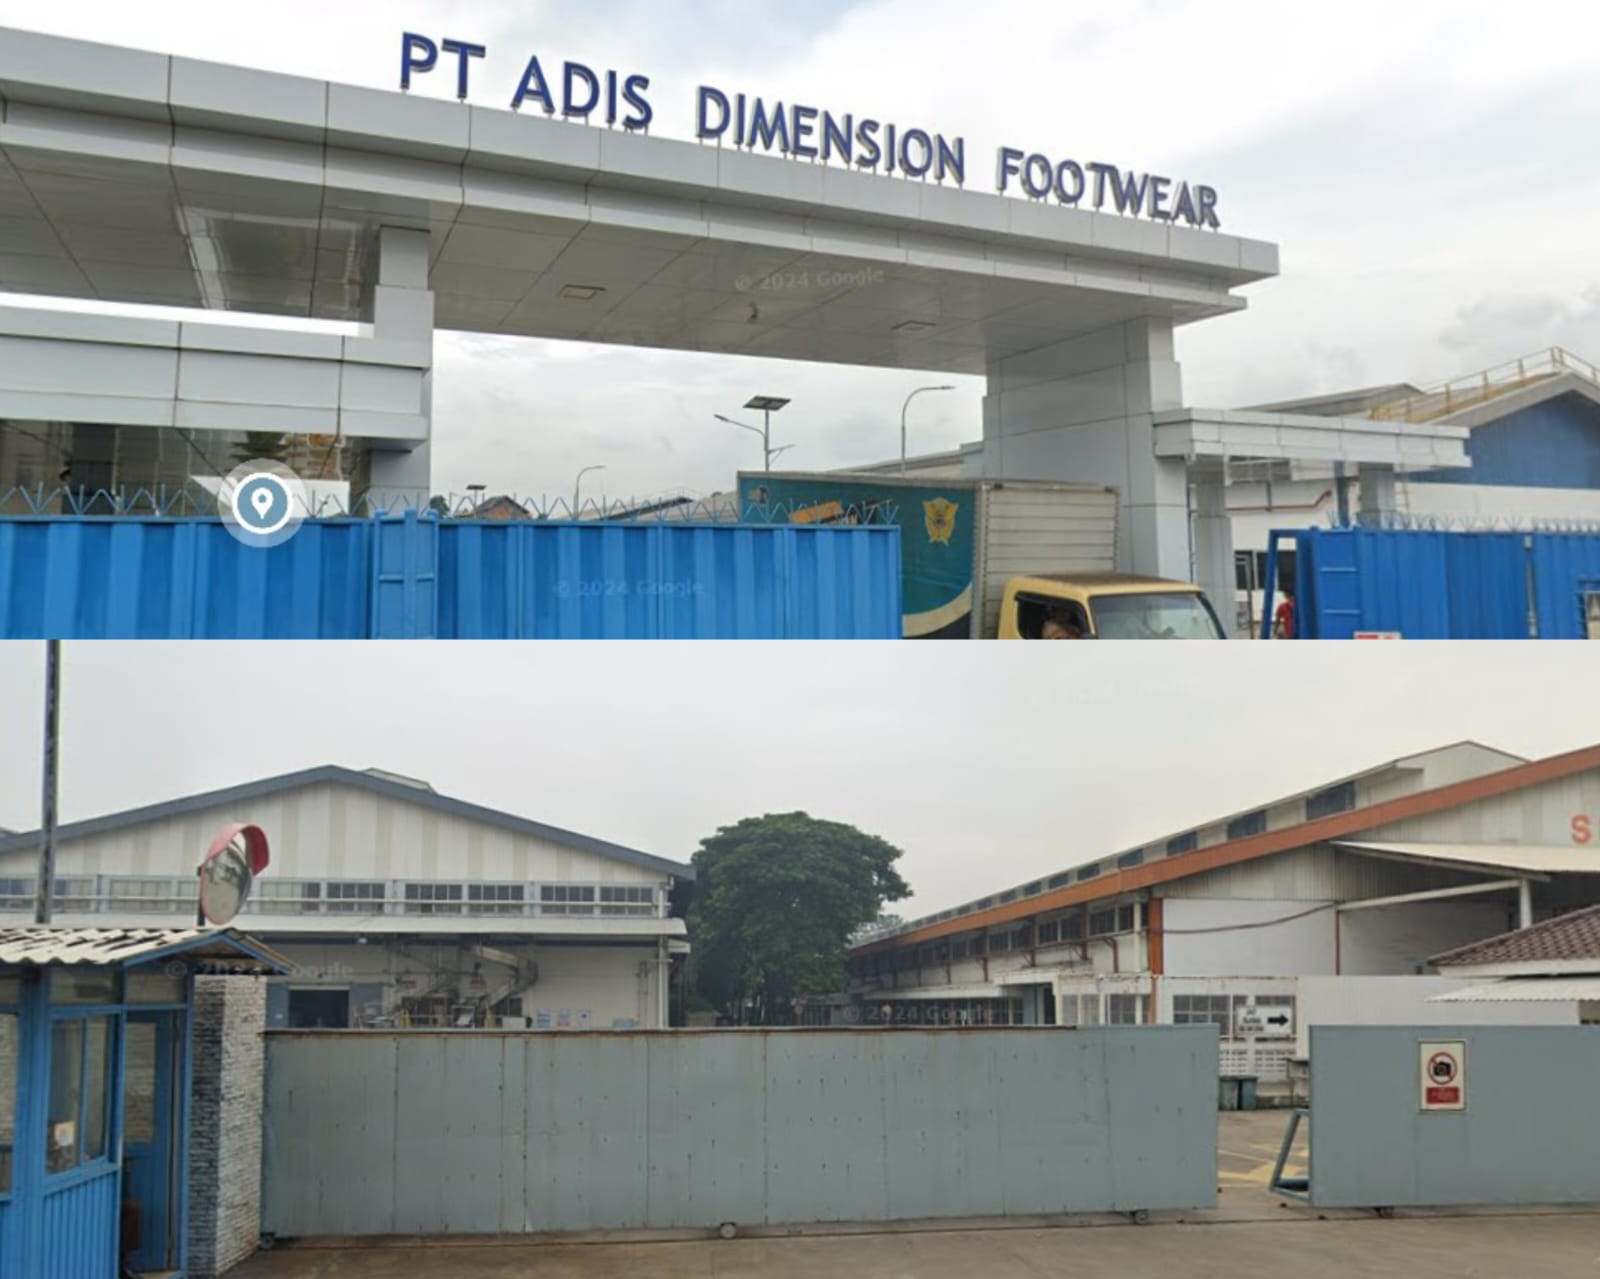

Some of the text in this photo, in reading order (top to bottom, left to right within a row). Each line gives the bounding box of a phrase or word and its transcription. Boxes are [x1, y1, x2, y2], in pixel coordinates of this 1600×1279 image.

[401, 31, 1221, 228] PT ADIS DIMENSION FOOTWEAR
[1570, 813, 1600, 846] S
